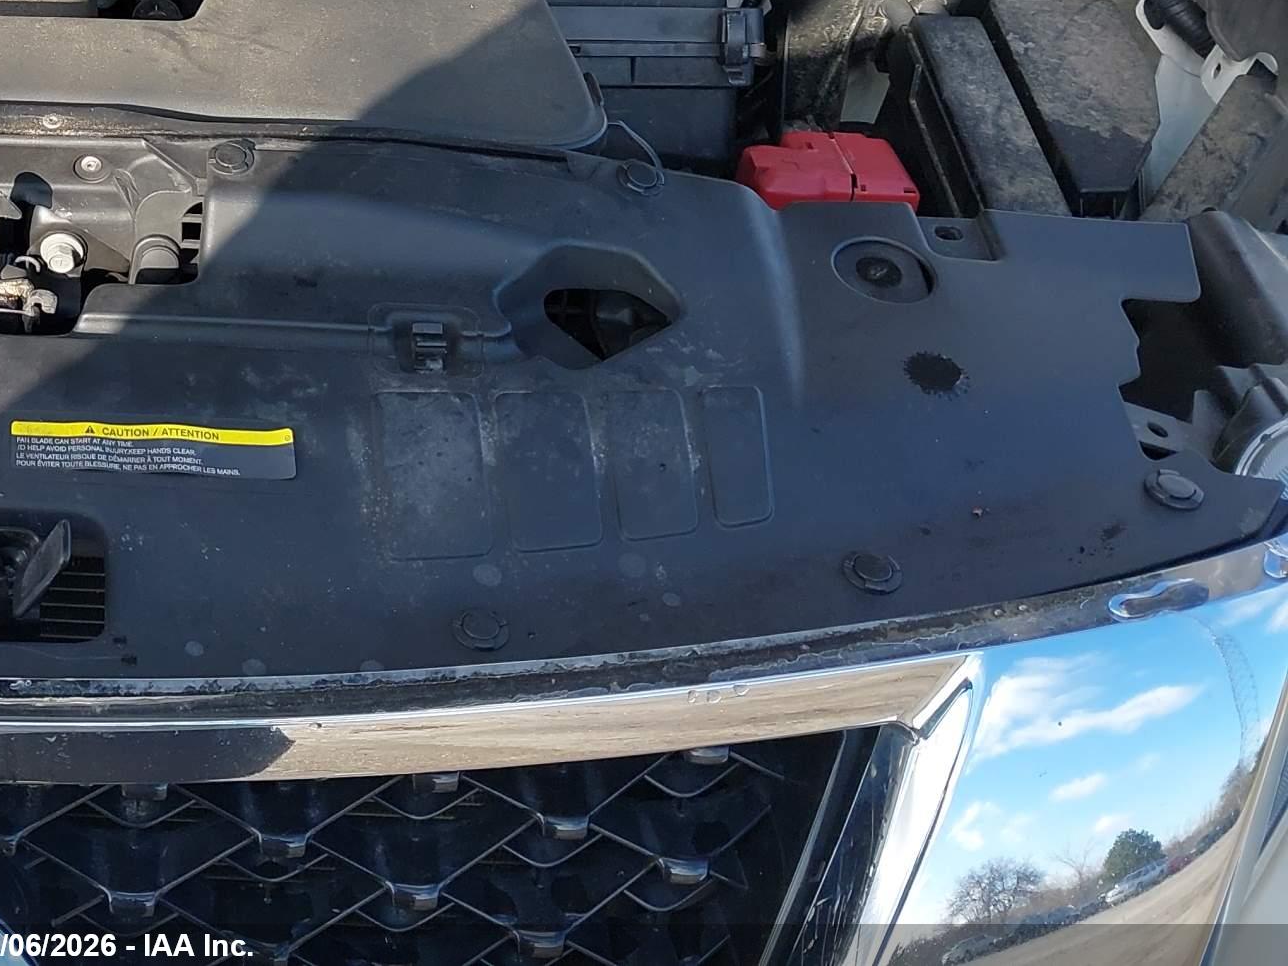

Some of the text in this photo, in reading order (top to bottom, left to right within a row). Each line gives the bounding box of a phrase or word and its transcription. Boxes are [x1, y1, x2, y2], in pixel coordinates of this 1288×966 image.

[101, 427, 149, 437] CAUTION
[161, 428, 219, 440] ATTENTION
[68, 445, 104, 453] PERSONAL
[25, 452, 70, 460] VENTILATEUR
[108, 454, 146, 463] DÉMARRER
[172, 457, 204, 465] MOMENT.
[37, 459, 60, 467] ÉVITER
[85, 461, 122, 470] BLESSURE,
[159, 464, 202, 472] APPROCHER
[216, 468, 241, 476] MAINS.
